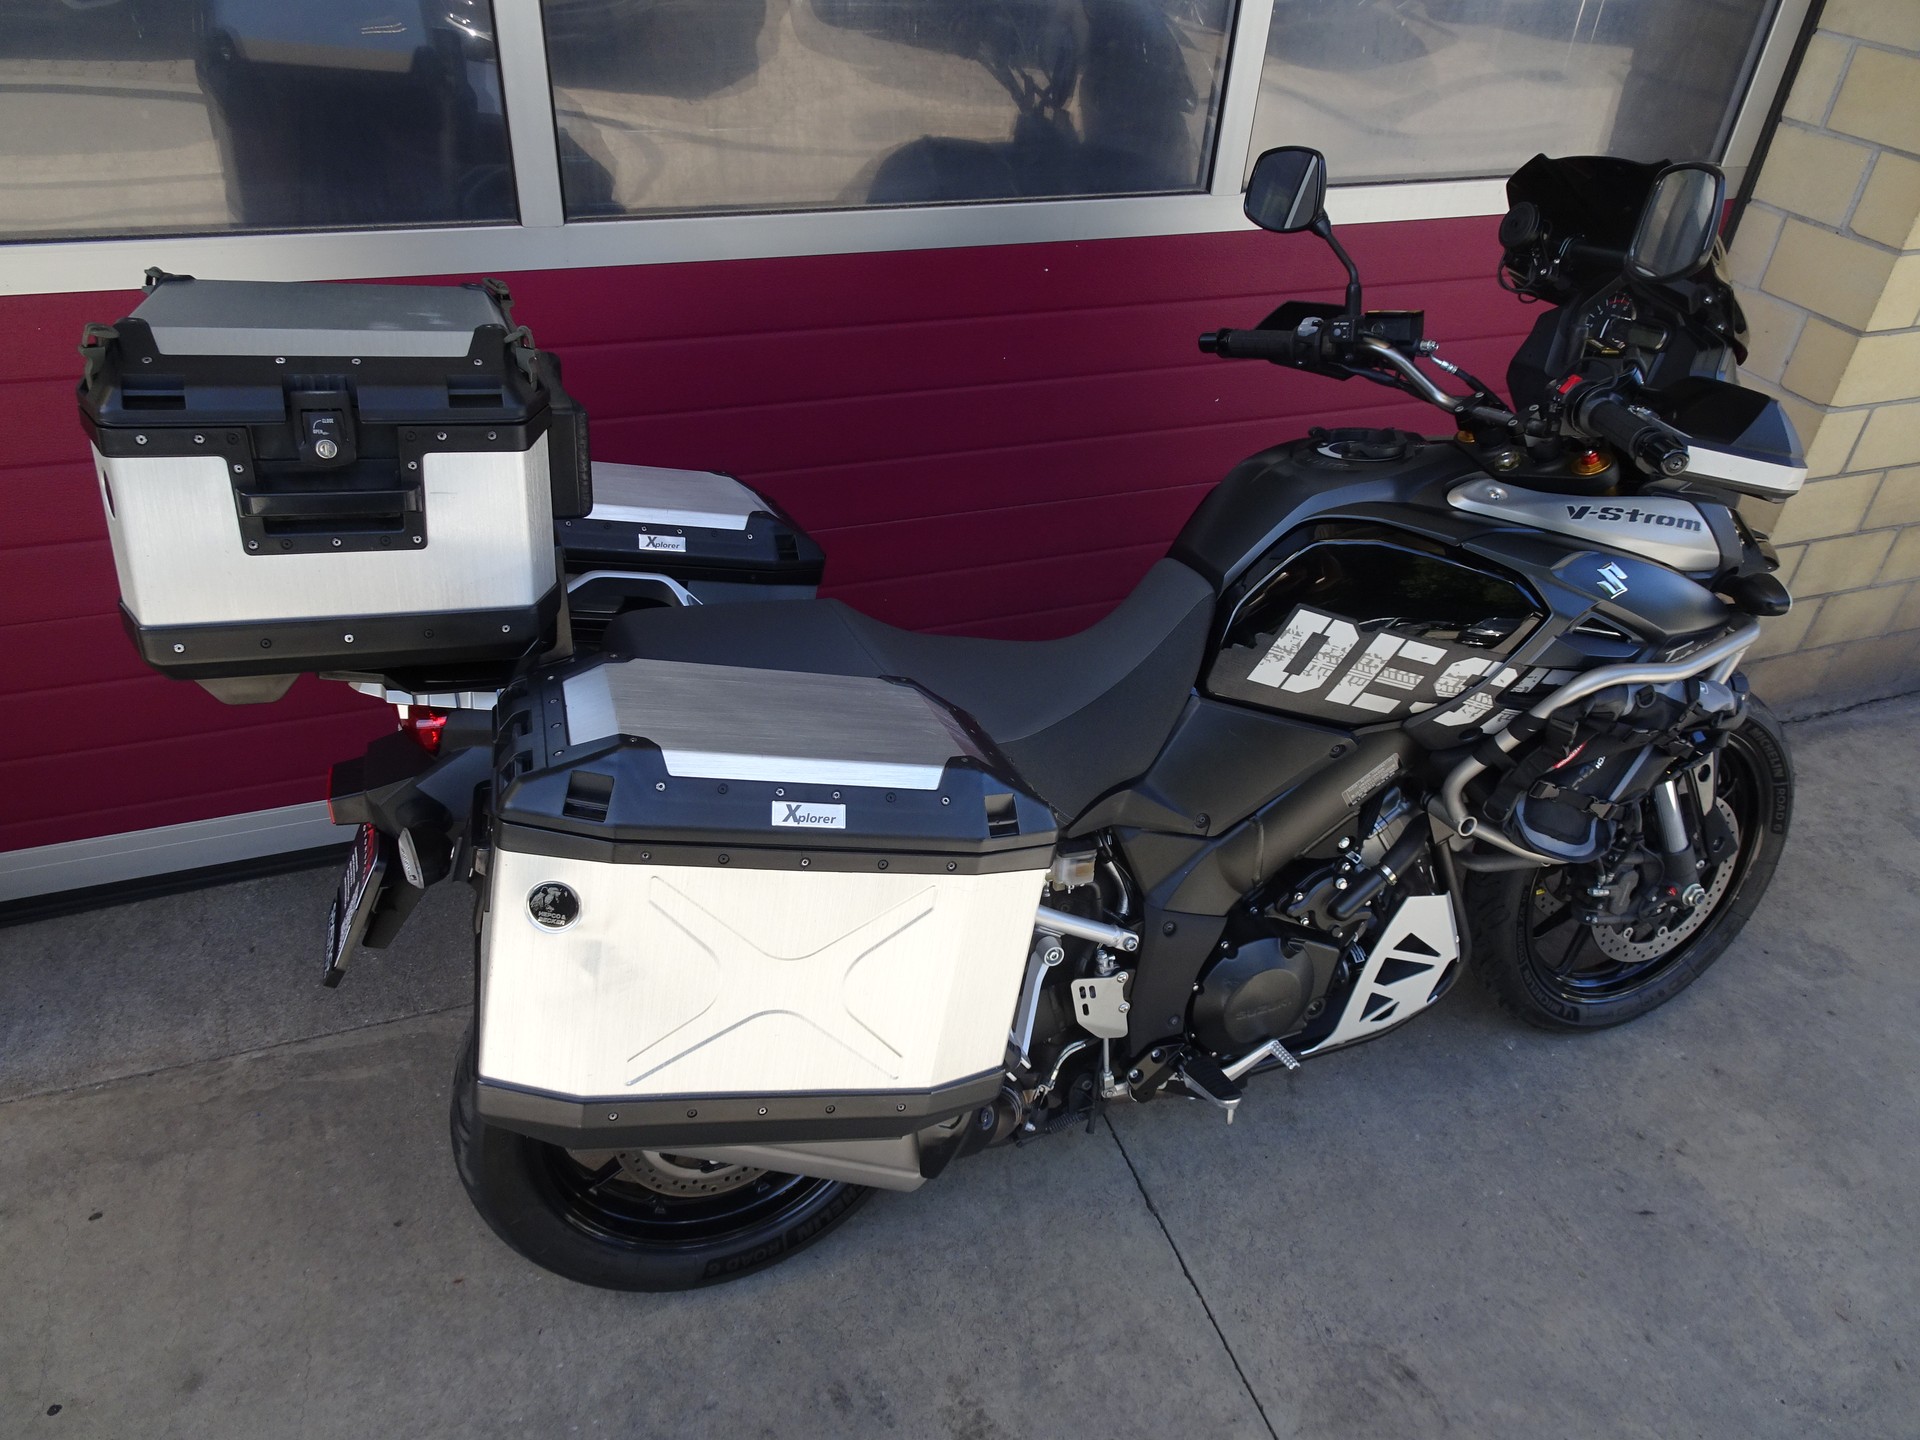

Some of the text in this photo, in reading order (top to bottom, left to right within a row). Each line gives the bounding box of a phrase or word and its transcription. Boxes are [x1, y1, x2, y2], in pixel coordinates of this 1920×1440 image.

[1566, 505, 1702, 532] V-Strom
[645, 535, 680, 549] Xplorer
[1748, 726, 1785, 778] MICHELIN
[1775, 787, 1786, 820] ROAD
[782, 803, 837, 825] Xplorer
